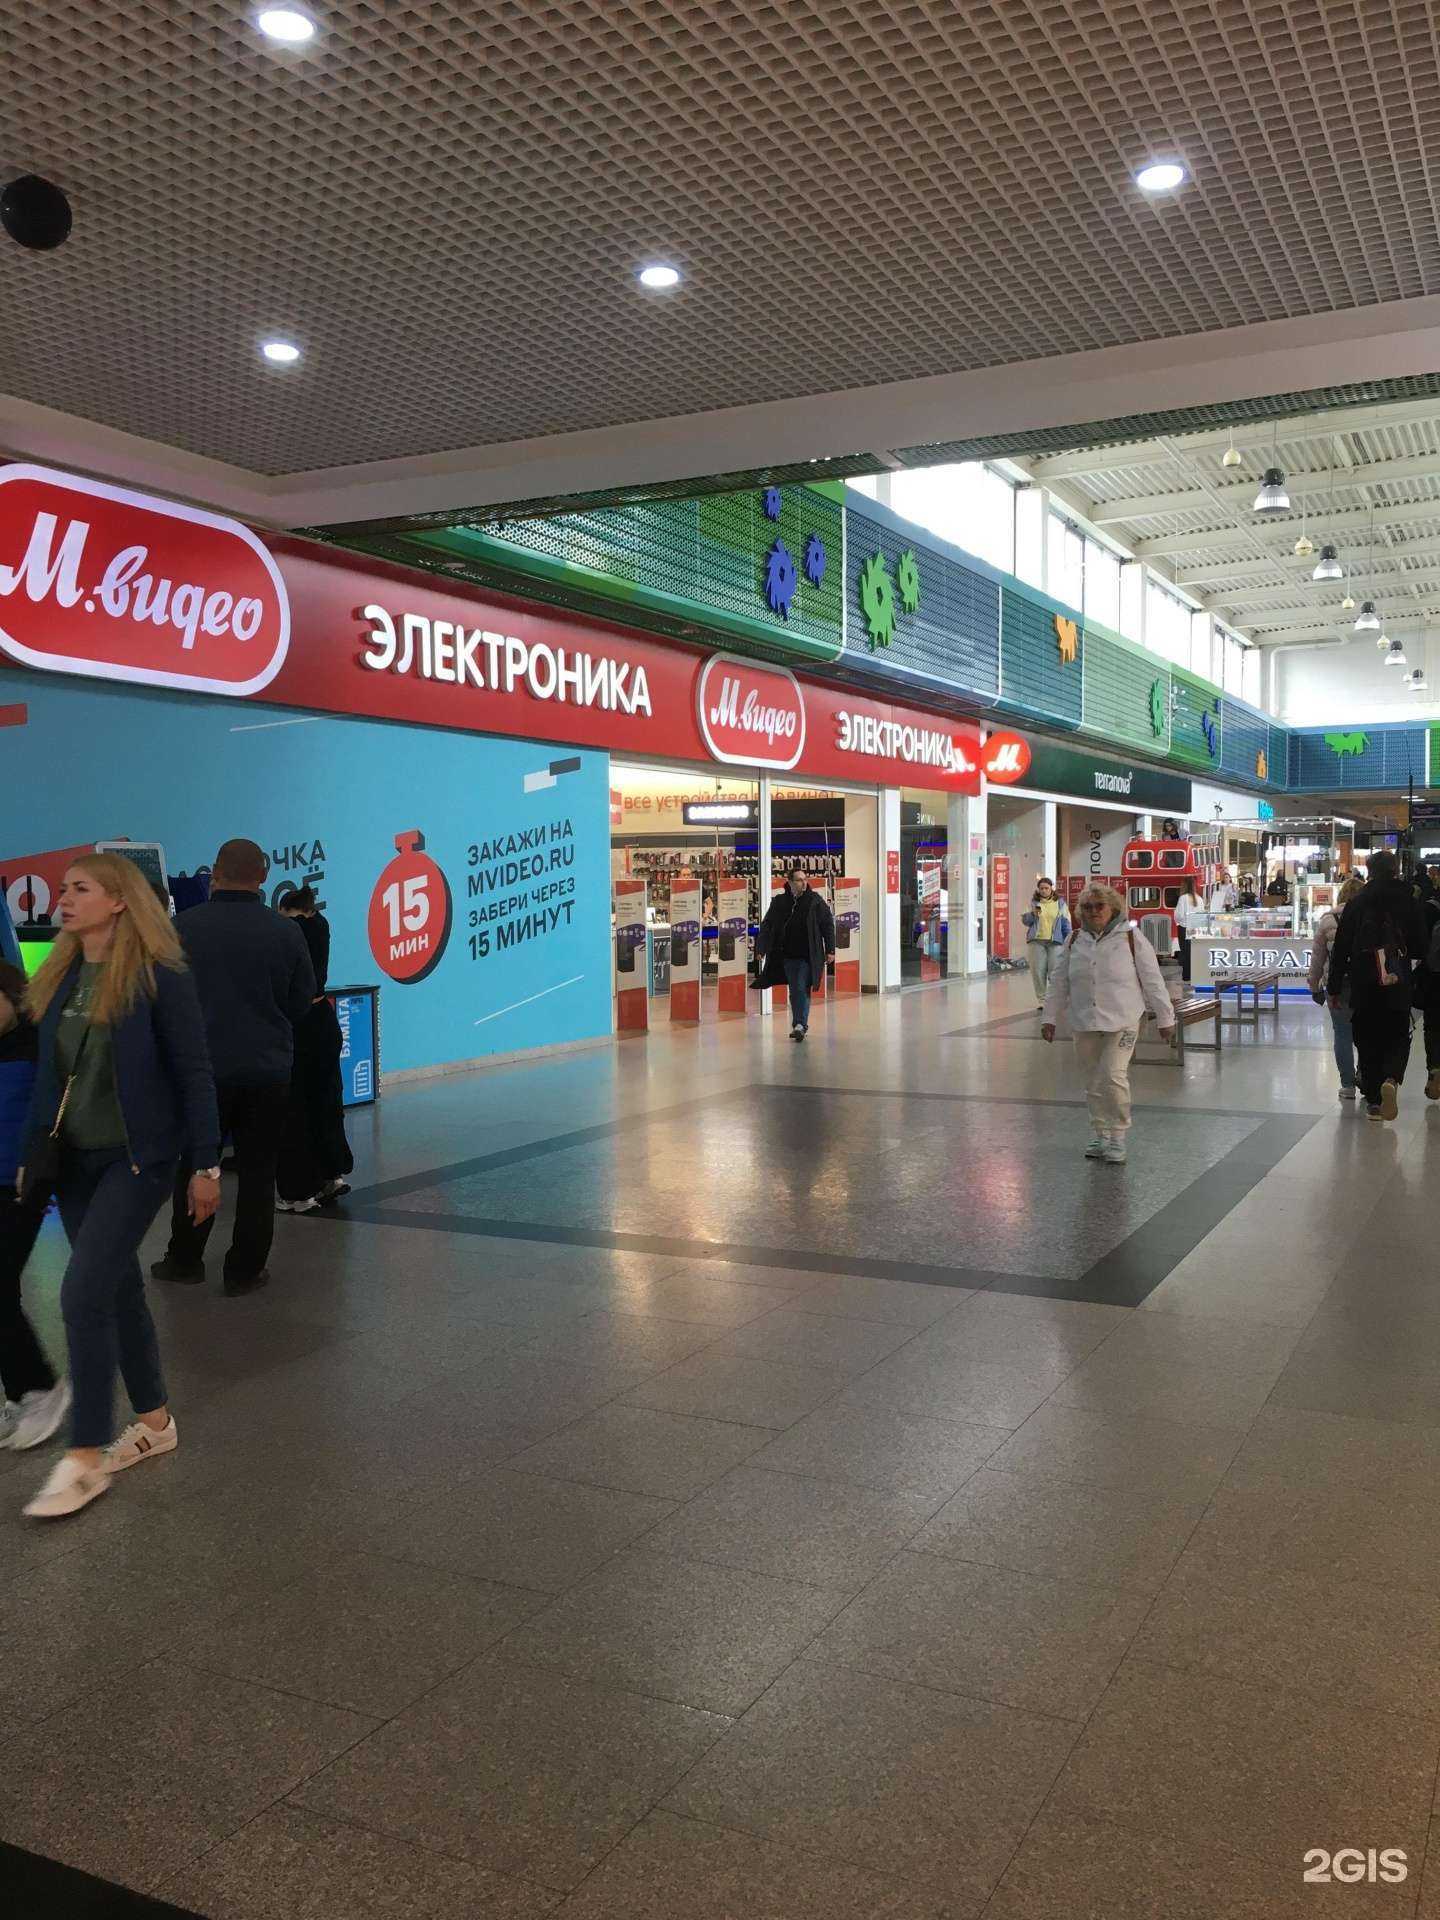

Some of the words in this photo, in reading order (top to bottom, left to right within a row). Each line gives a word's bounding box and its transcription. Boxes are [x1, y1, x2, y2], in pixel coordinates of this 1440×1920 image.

[361, 604, 652, 717] ЭЛЕКТРОНИКА
[837, 711, 954, 768] ЭЛЕКТРОНИКА
[467, 825, 546, 867] ЗАКАЖИ
[550, 818, 573, 842] НА
[467, 844, 575, 898] MVIDEO.RU
[382, 874, 430, 938] 15
[468, 893, 528, 928] ЗАБЕРИ
[531, 876, 575, 905] ЧЕРЕЗ
[390, 933, 429, 961] МИН
[468, 930, 490, 961] 15
[496, 899, 575, 951] МИНУТ
